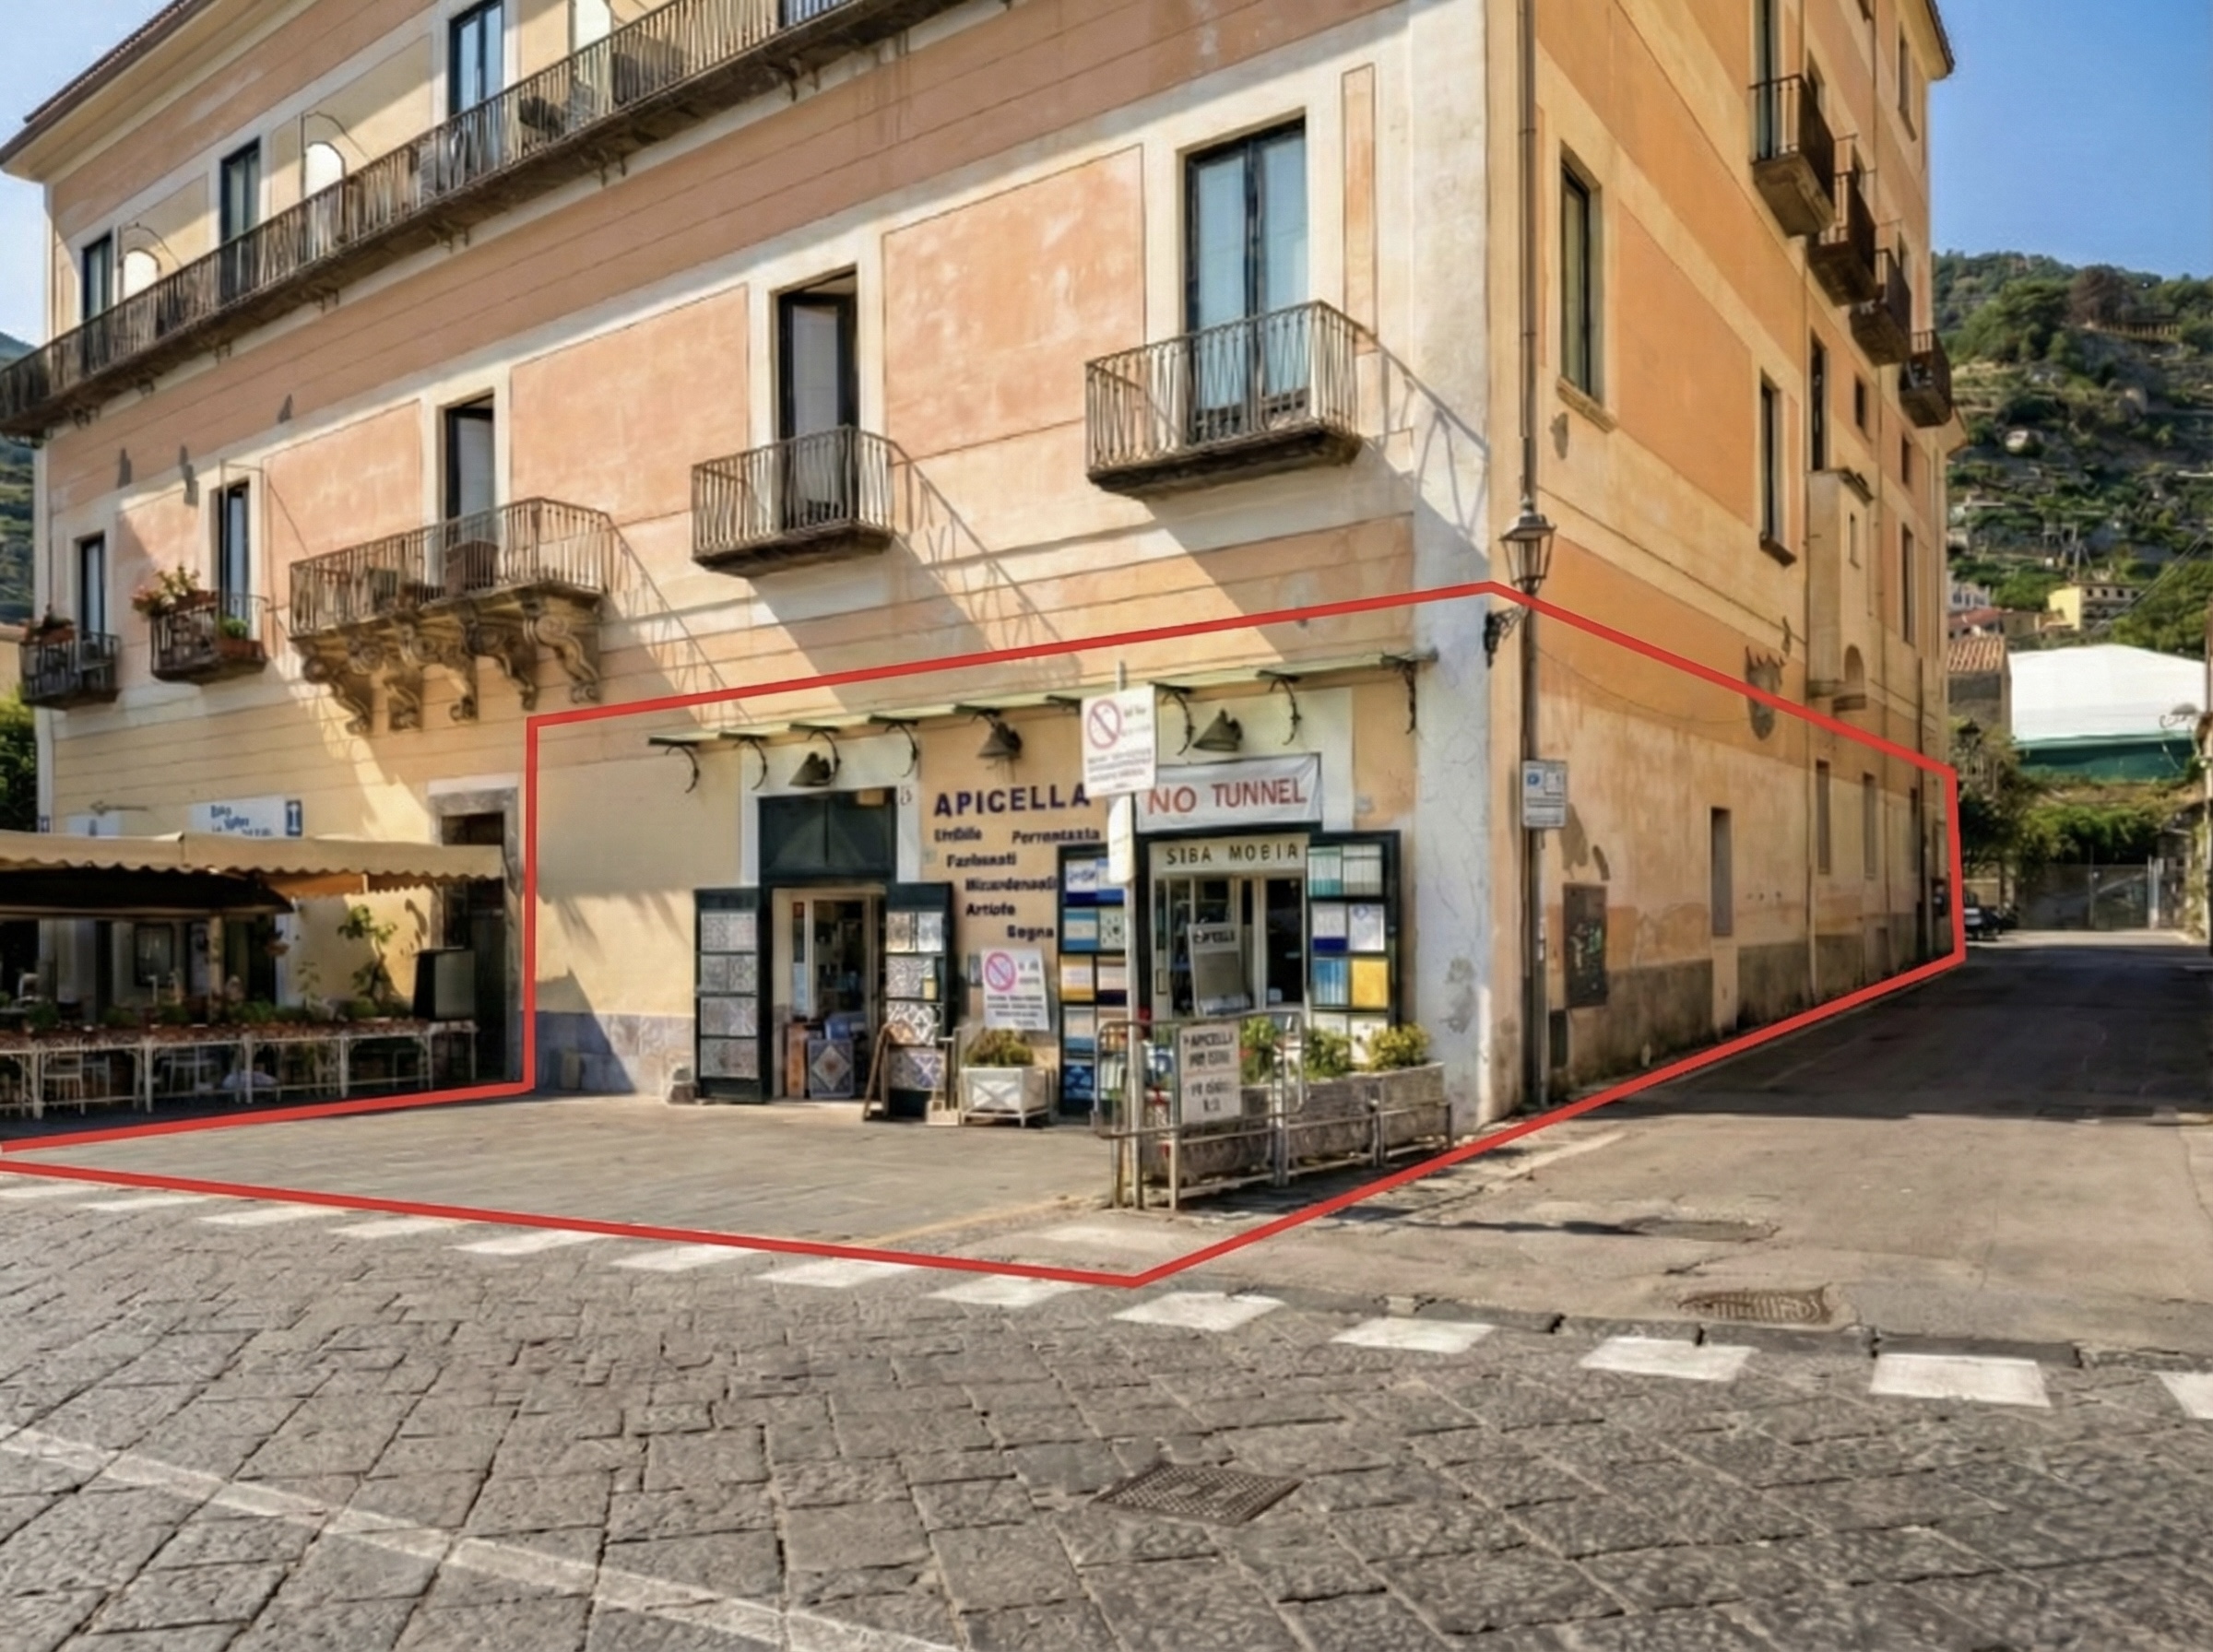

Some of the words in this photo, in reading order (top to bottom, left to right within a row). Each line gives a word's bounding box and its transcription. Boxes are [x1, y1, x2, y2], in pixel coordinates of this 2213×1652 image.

[934, 783, 1091, 818] APICELLA
[1148, 785, 1197, 815] NO
[1212, 777, 1308, 808] TUNNEL
